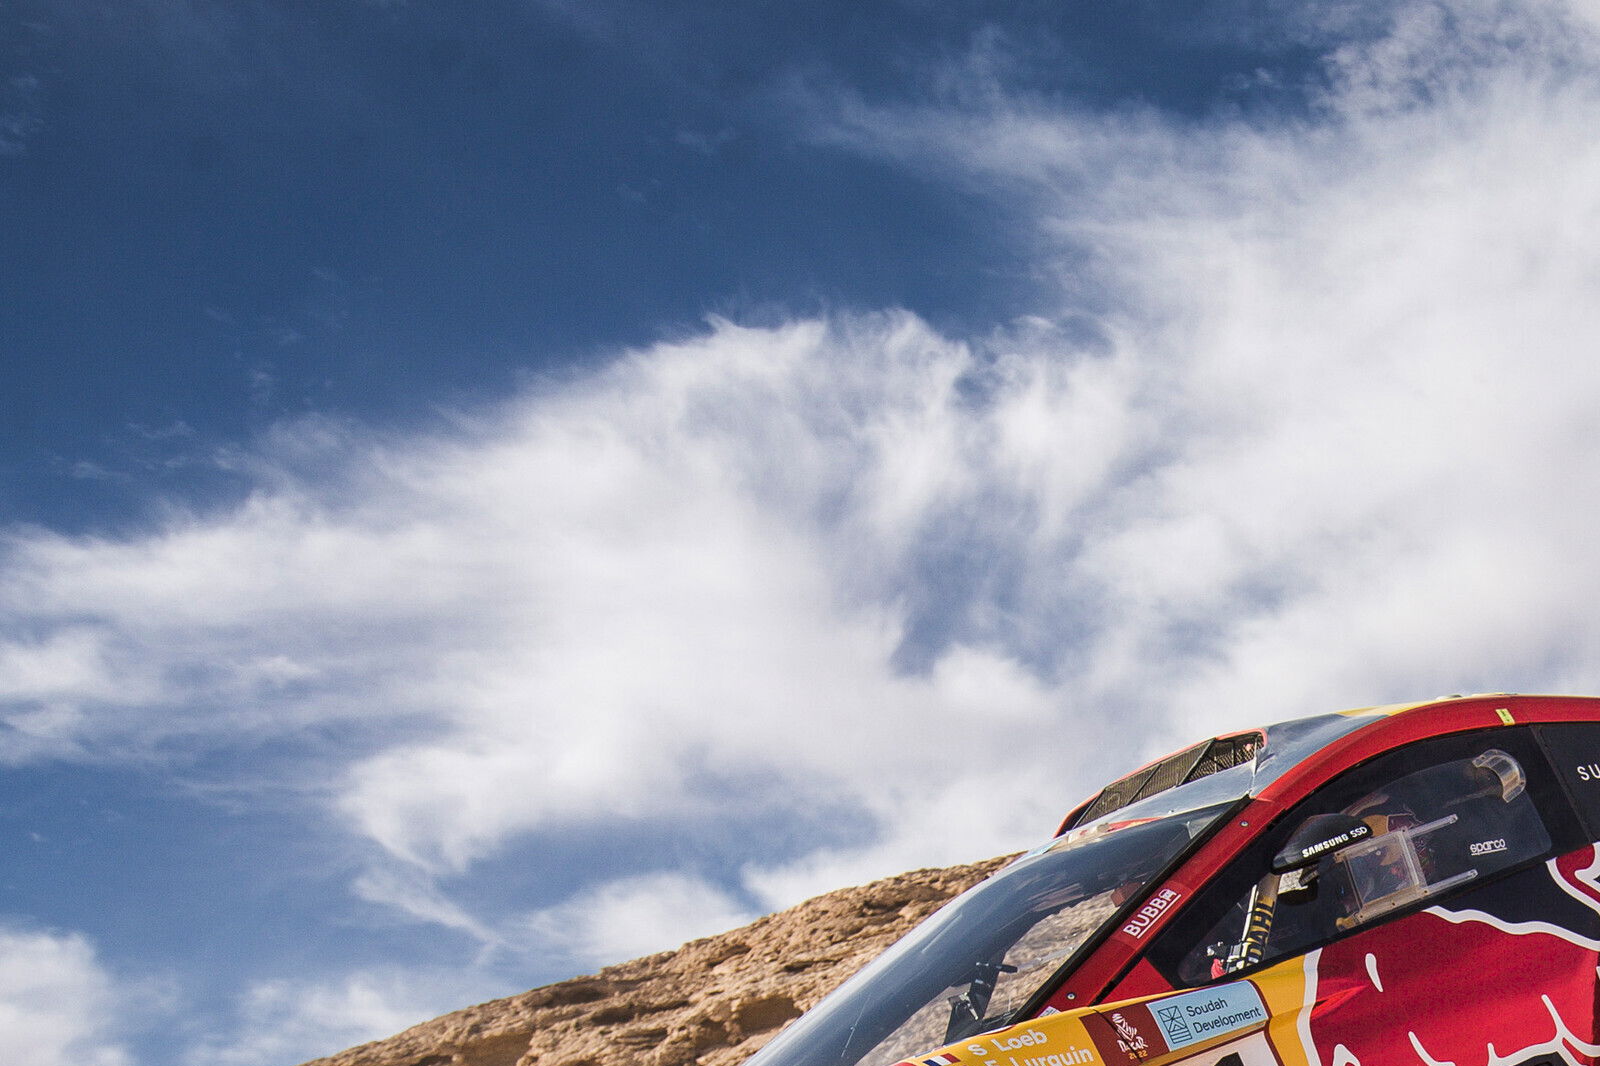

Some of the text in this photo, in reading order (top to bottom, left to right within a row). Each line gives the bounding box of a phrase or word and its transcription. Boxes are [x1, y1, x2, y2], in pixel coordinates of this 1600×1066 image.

[1302, 826, 1368, 858] SAMSUNG SSD
[1186, 998, 1229, 1017] Soudah
[1193, 1007, 1262, 1034] Development
[968, 1029, 1048, 1056] S Loeb
